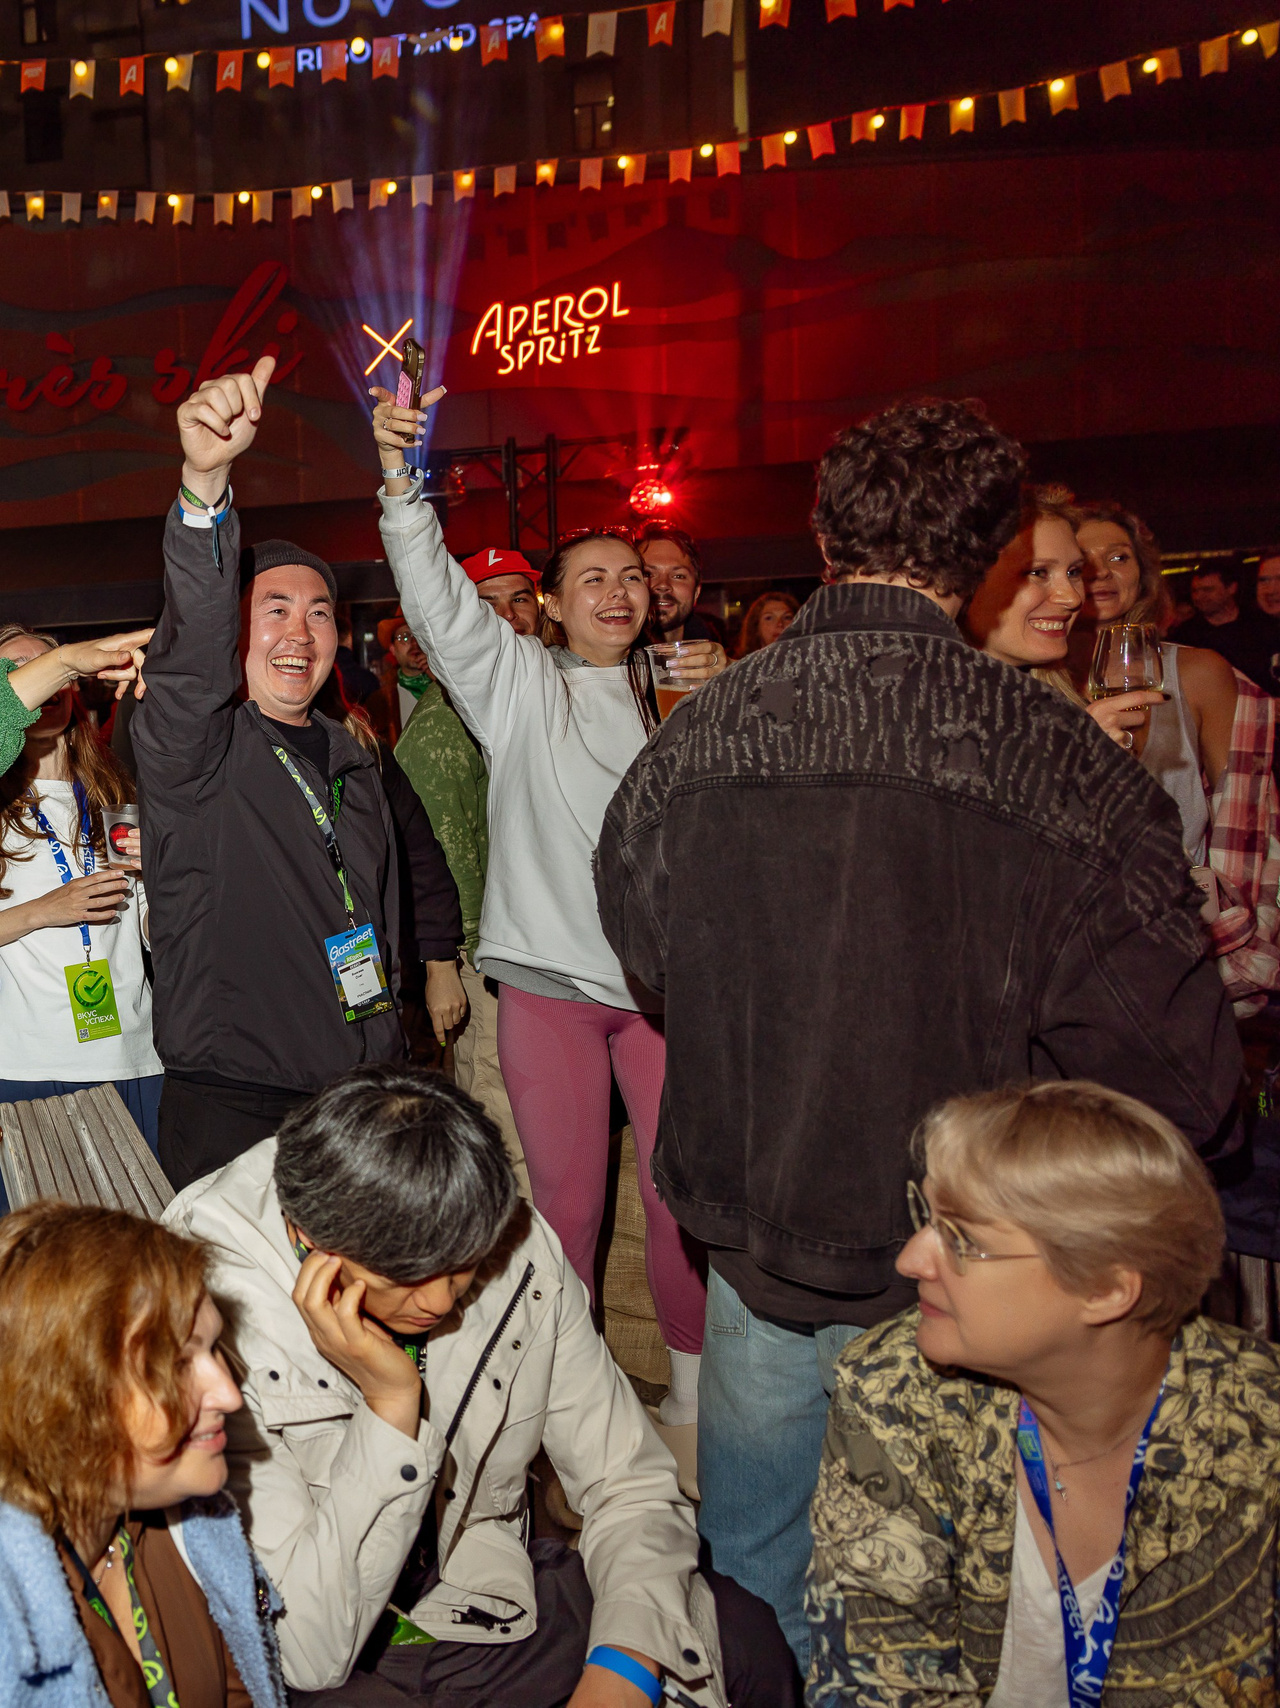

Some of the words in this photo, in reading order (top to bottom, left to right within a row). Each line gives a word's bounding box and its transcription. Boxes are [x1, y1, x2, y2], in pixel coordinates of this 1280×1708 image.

[124, 64, 137, 84] A
[222, 61, 235, 81] A
[470, 280, 630, 356] APEROL
[329, 927, 373, 961] Gastreet
[76, 1009, 98, 1020] ВКУС
[84, 1014, 115, 1026] УСПЕХА
